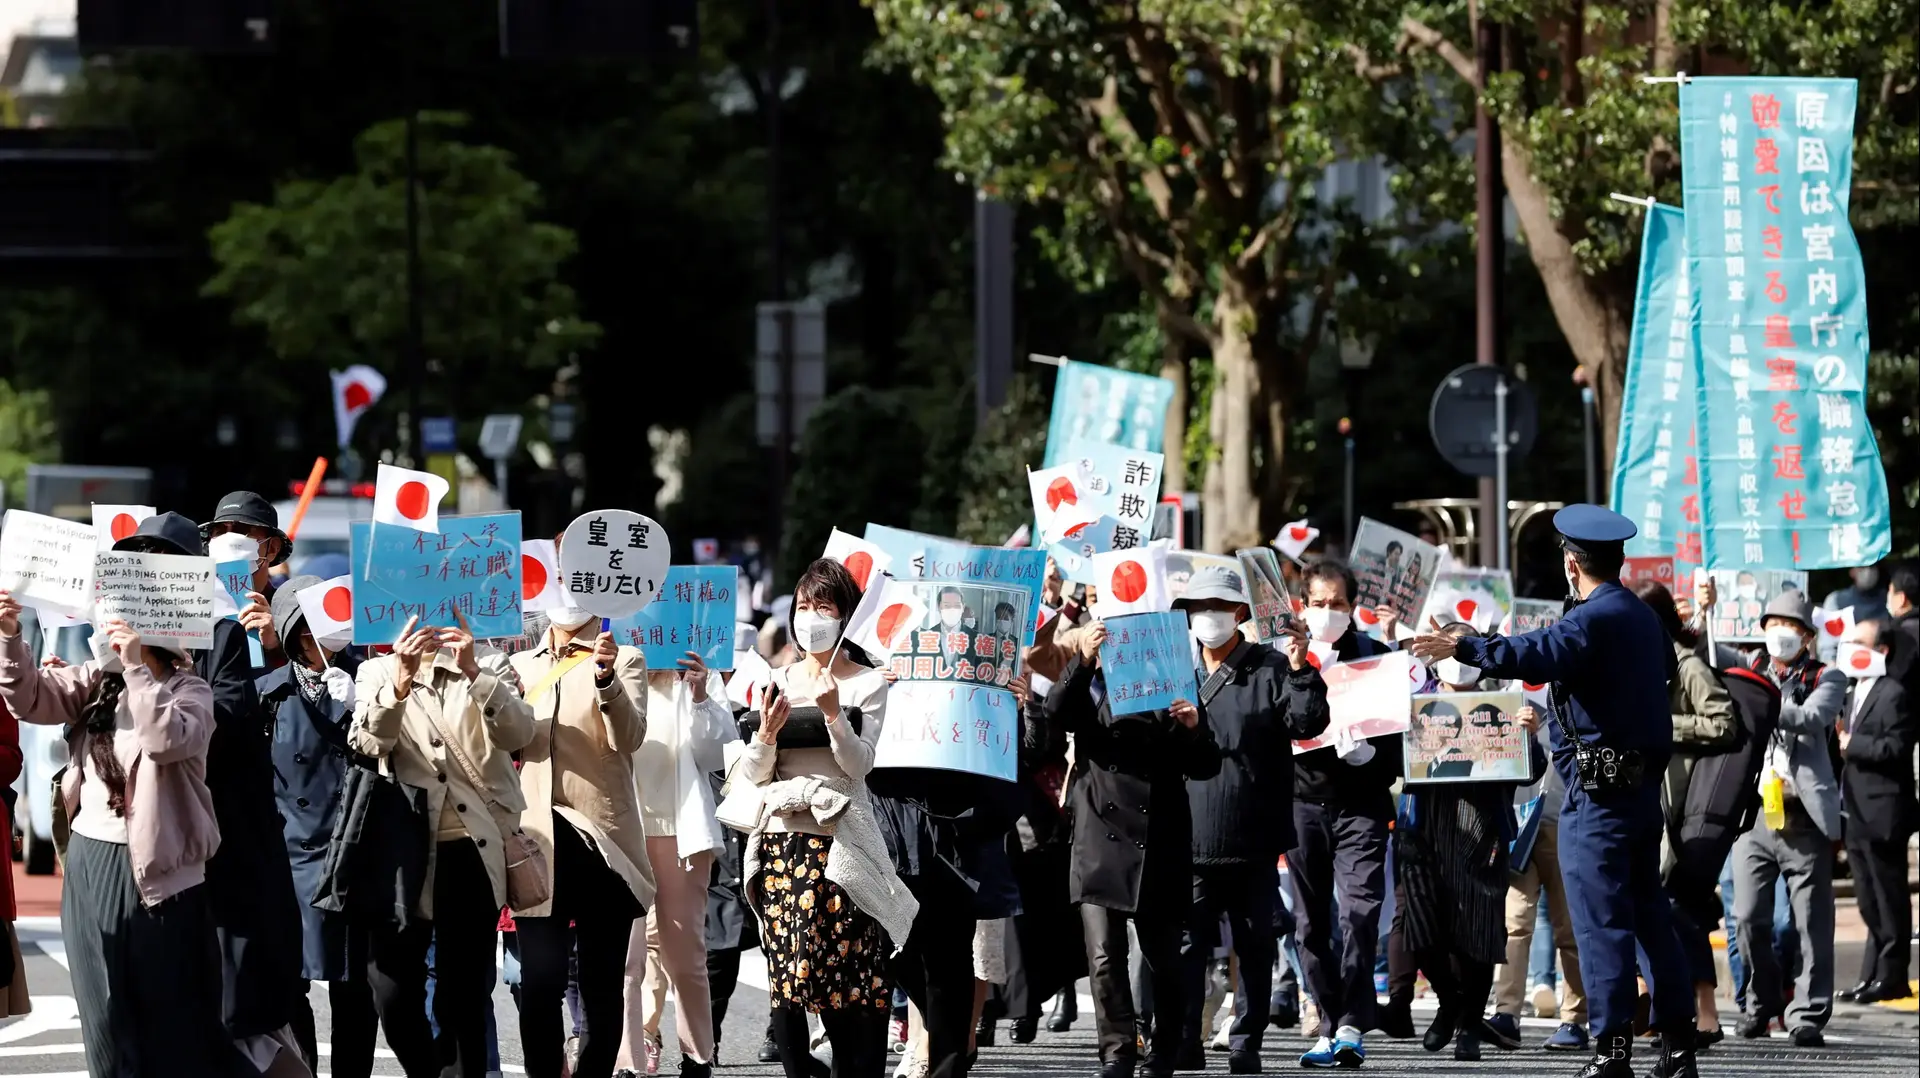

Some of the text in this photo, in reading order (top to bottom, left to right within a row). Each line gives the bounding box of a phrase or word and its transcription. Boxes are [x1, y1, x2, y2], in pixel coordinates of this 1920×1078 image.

[1795, 92, 1862, 561] 原因は宮内庁の職務怠慢
[413, 522, 500, 554] 不正入学
[587, 516, 649, 549] 皇室
[414, 550, 513, 581] コネ就職
[608, 549, 624, 570] を
[97, 568, 157, 580] LAW-ABIDING
[1013, 562, 1041, 580] WAS
[139, 584, 167, 593] Pension
[170, 584, 195, 593] Fraud
[571, 570, 654, 595] 護りたい
[145, 596, 194, 607] Applications
[149, 610, 166, 618] Sick
[176, 610, 212, 619] Wounded
[154, 621, 183, 630] Profile
[625, 624, 728, 649] 濫用を許すな
[892, 656, 1013, 686] 利用したのか
[1463, 711, 1492, 723] will
[1501, 724, 1521, 734] for
[1482, 750, 1523, 760] from?
